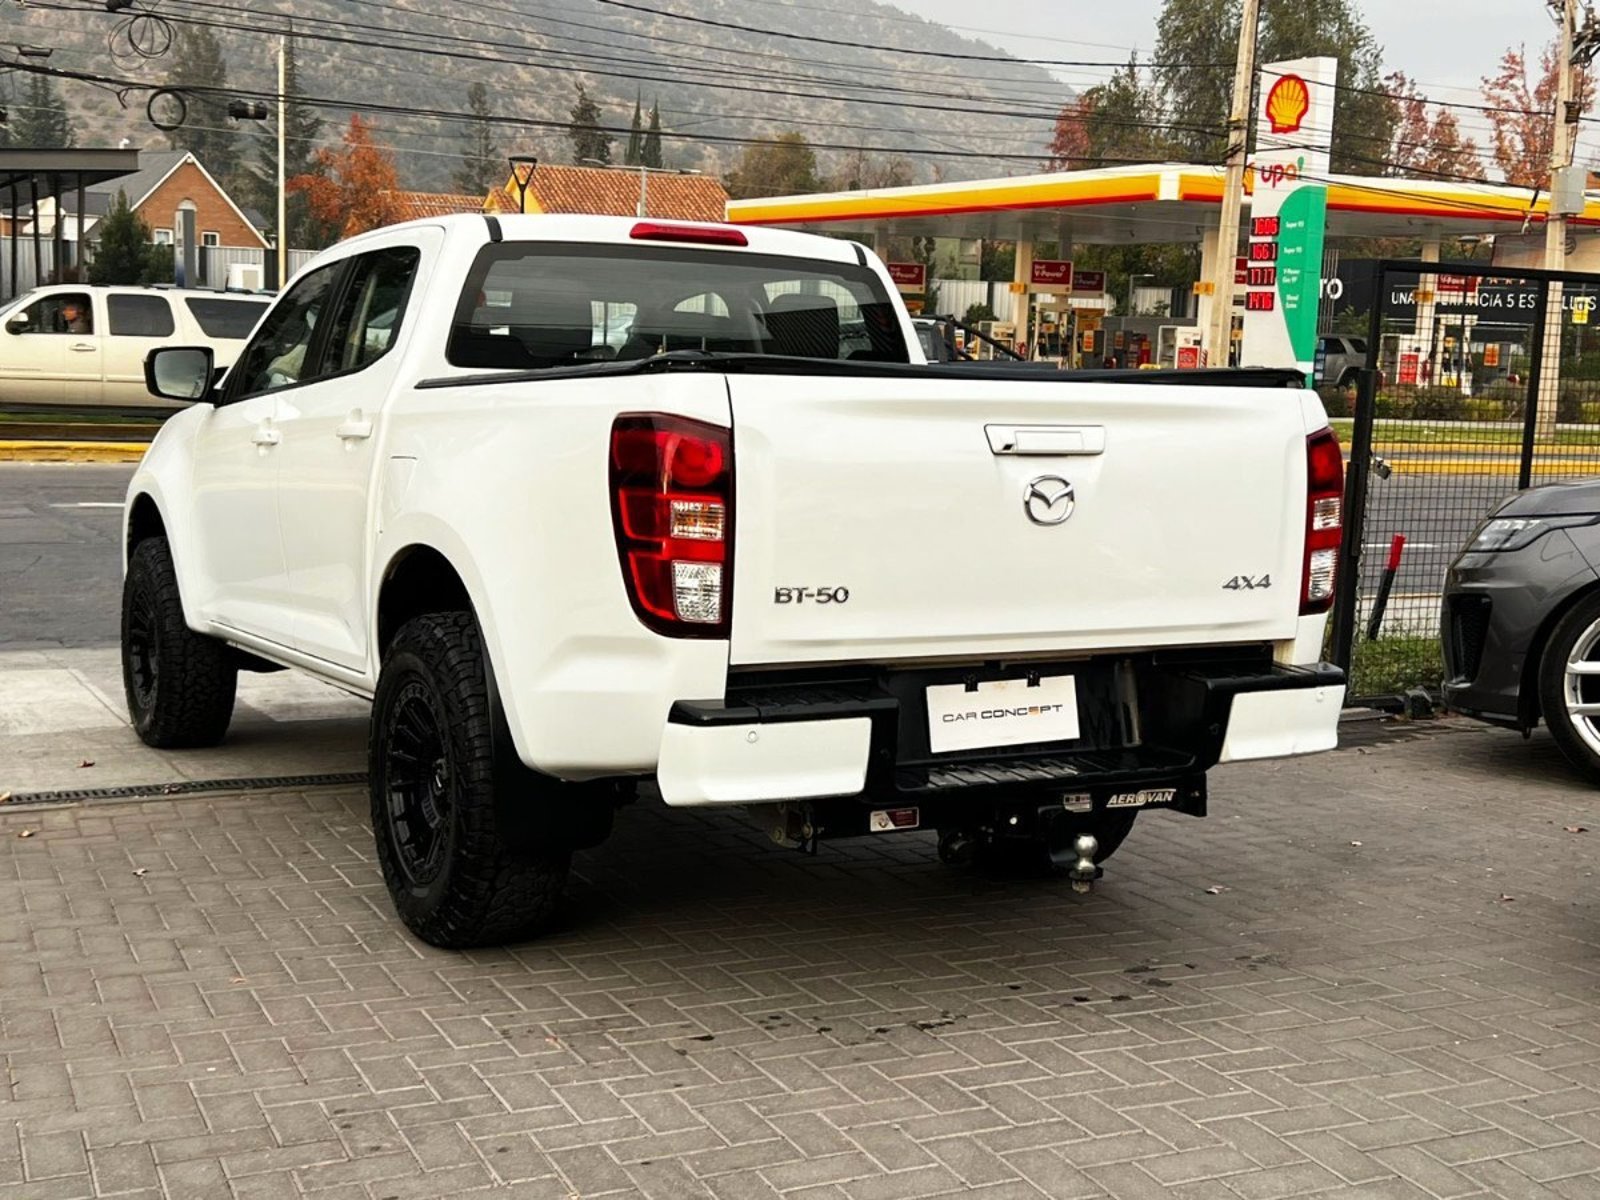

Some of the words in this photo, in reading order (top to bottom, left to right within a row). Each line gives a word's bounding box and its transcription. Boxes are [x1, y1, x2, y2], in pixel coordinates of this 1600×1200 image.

[1391, 291, 1416, 306] UNA
[1506, 294, 1516, 308] 5
[774, 586, 849, 605] BT-50
[942, 711, 977, 723] CAR
[981, 704, 1064, 720] CONCEPT
[1106, 789, 1176, 807] AEROVAN
